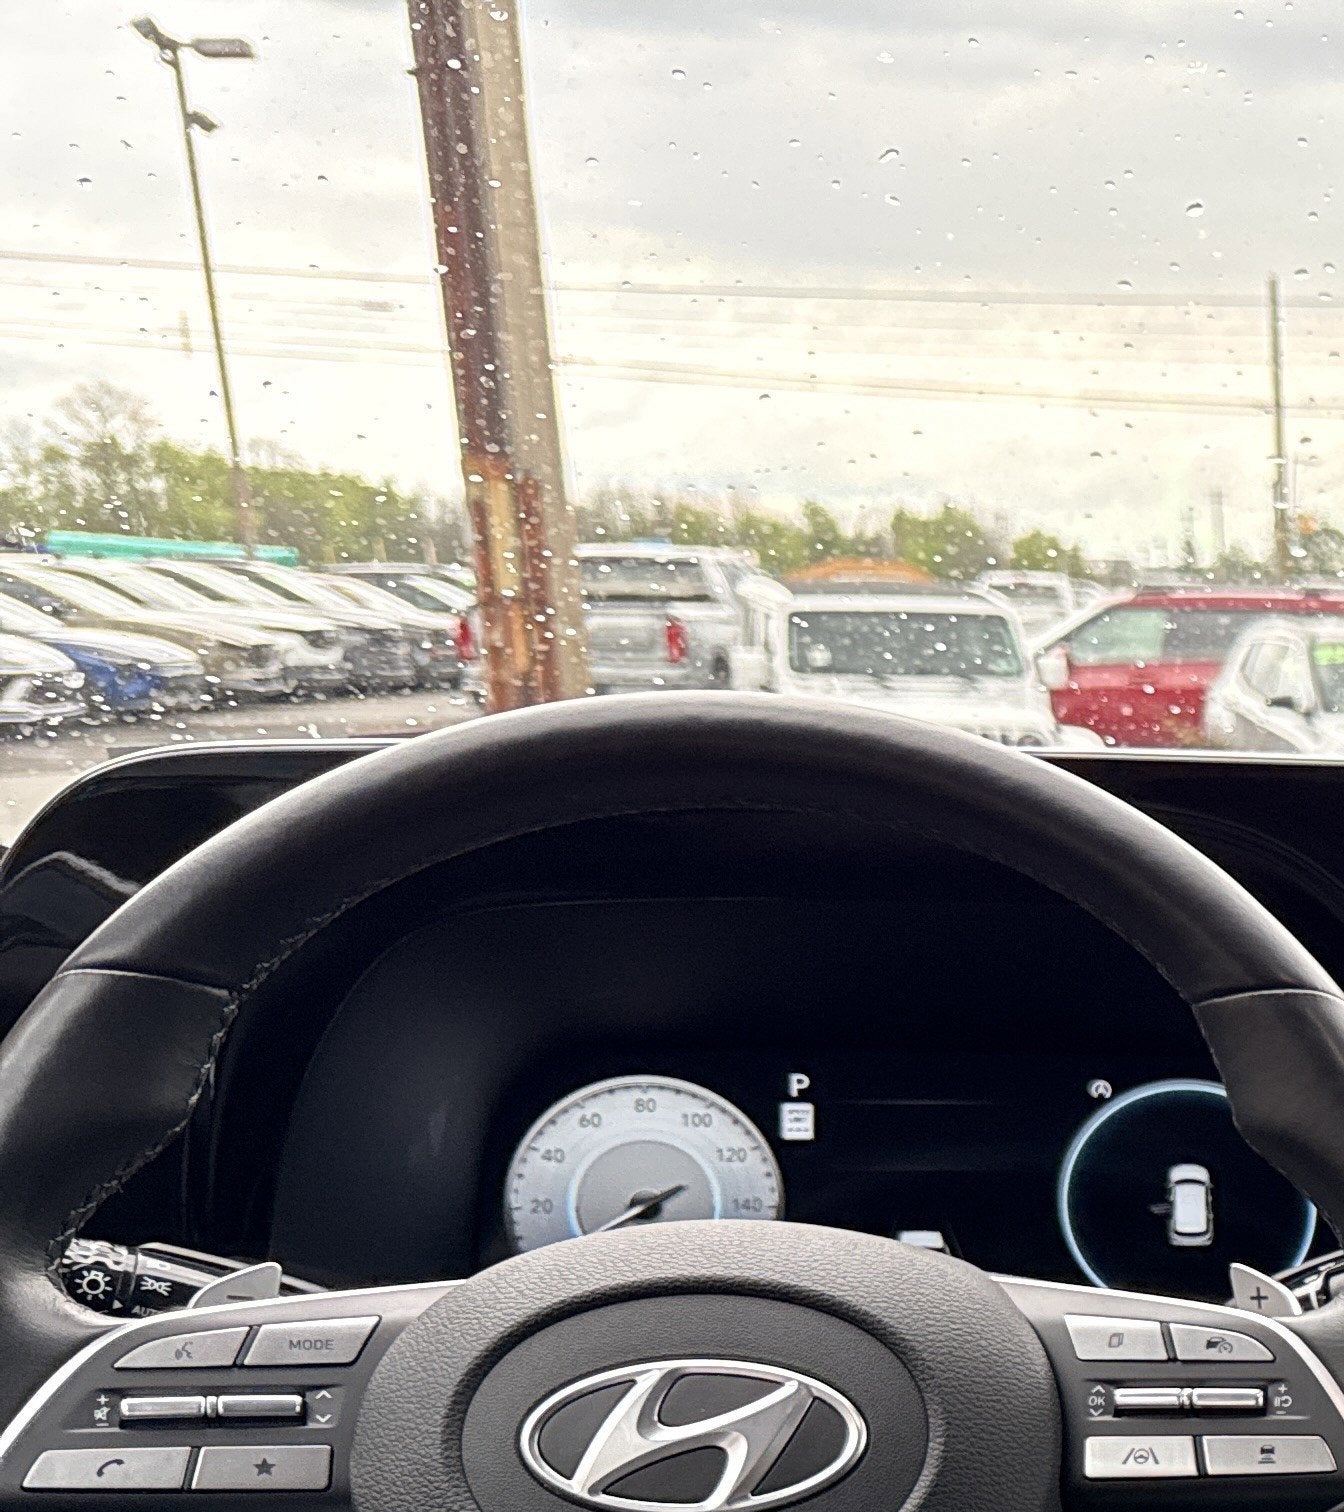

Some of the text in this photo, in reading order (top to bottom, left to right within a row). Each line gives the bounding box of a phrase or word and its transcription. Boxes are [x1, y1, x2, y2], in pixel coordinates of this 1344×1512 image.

[788, 1073, 811, 1098] P
[634, 1098, 656, 1113] 80
[579, 1113, 602, 1128] 60
[681, 1113, 713, 1128] 100
[541, 1148, 565, 1163] 40
[716, 1148, 748, 1163] 120
[530, 1199, 553, 1215] 20
[732, 1197, 763, 1213] 140
[131, 1304, 165, 1316] AUT
[288, 1339, 335, 1351] MODE
[1088, 1396, 1106, 1407] OK
